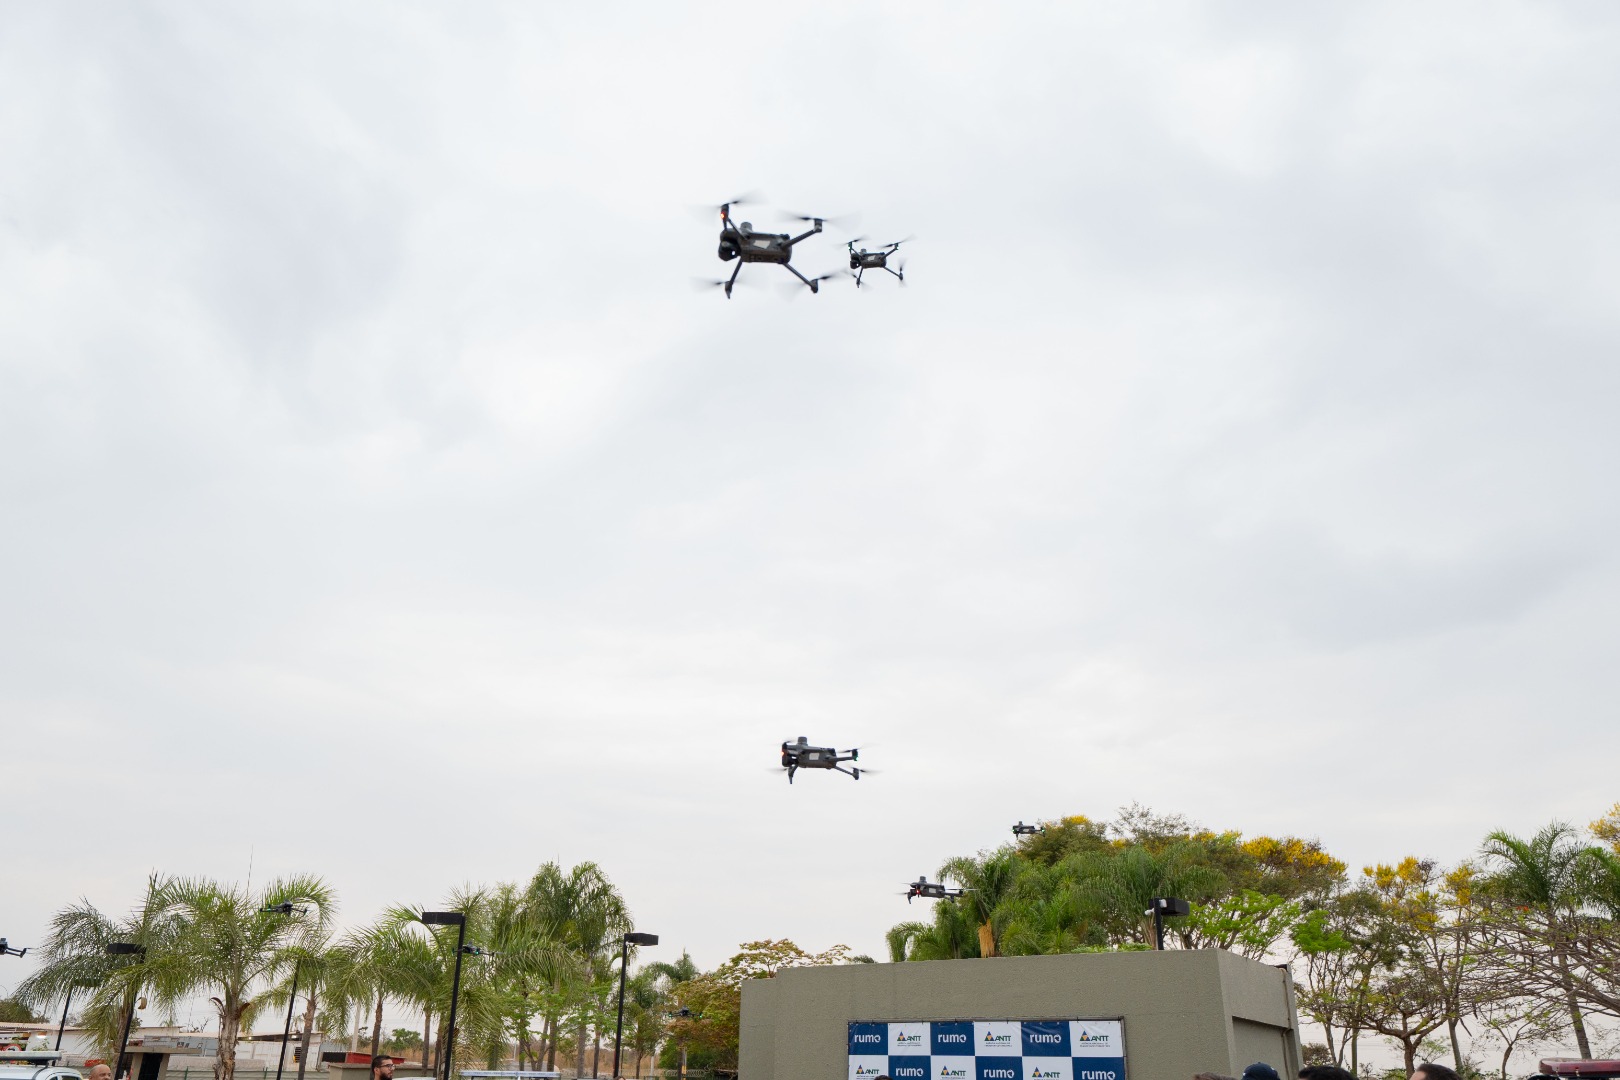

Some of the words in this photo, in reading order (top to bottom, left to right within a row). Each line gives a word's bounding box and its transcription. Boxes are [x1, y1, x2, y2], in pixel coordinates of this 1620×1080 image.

[854, 1034, 881, 1043] rumo
[938, 1034, 967, 1043] rumo
[1029, 1034, 1061, 1043] rumo
[895, 1067, 924, 1077] rumo
[983, 1068, 1015, 1078] rumo
[1081, 1070, 1116, 1080] rumo
